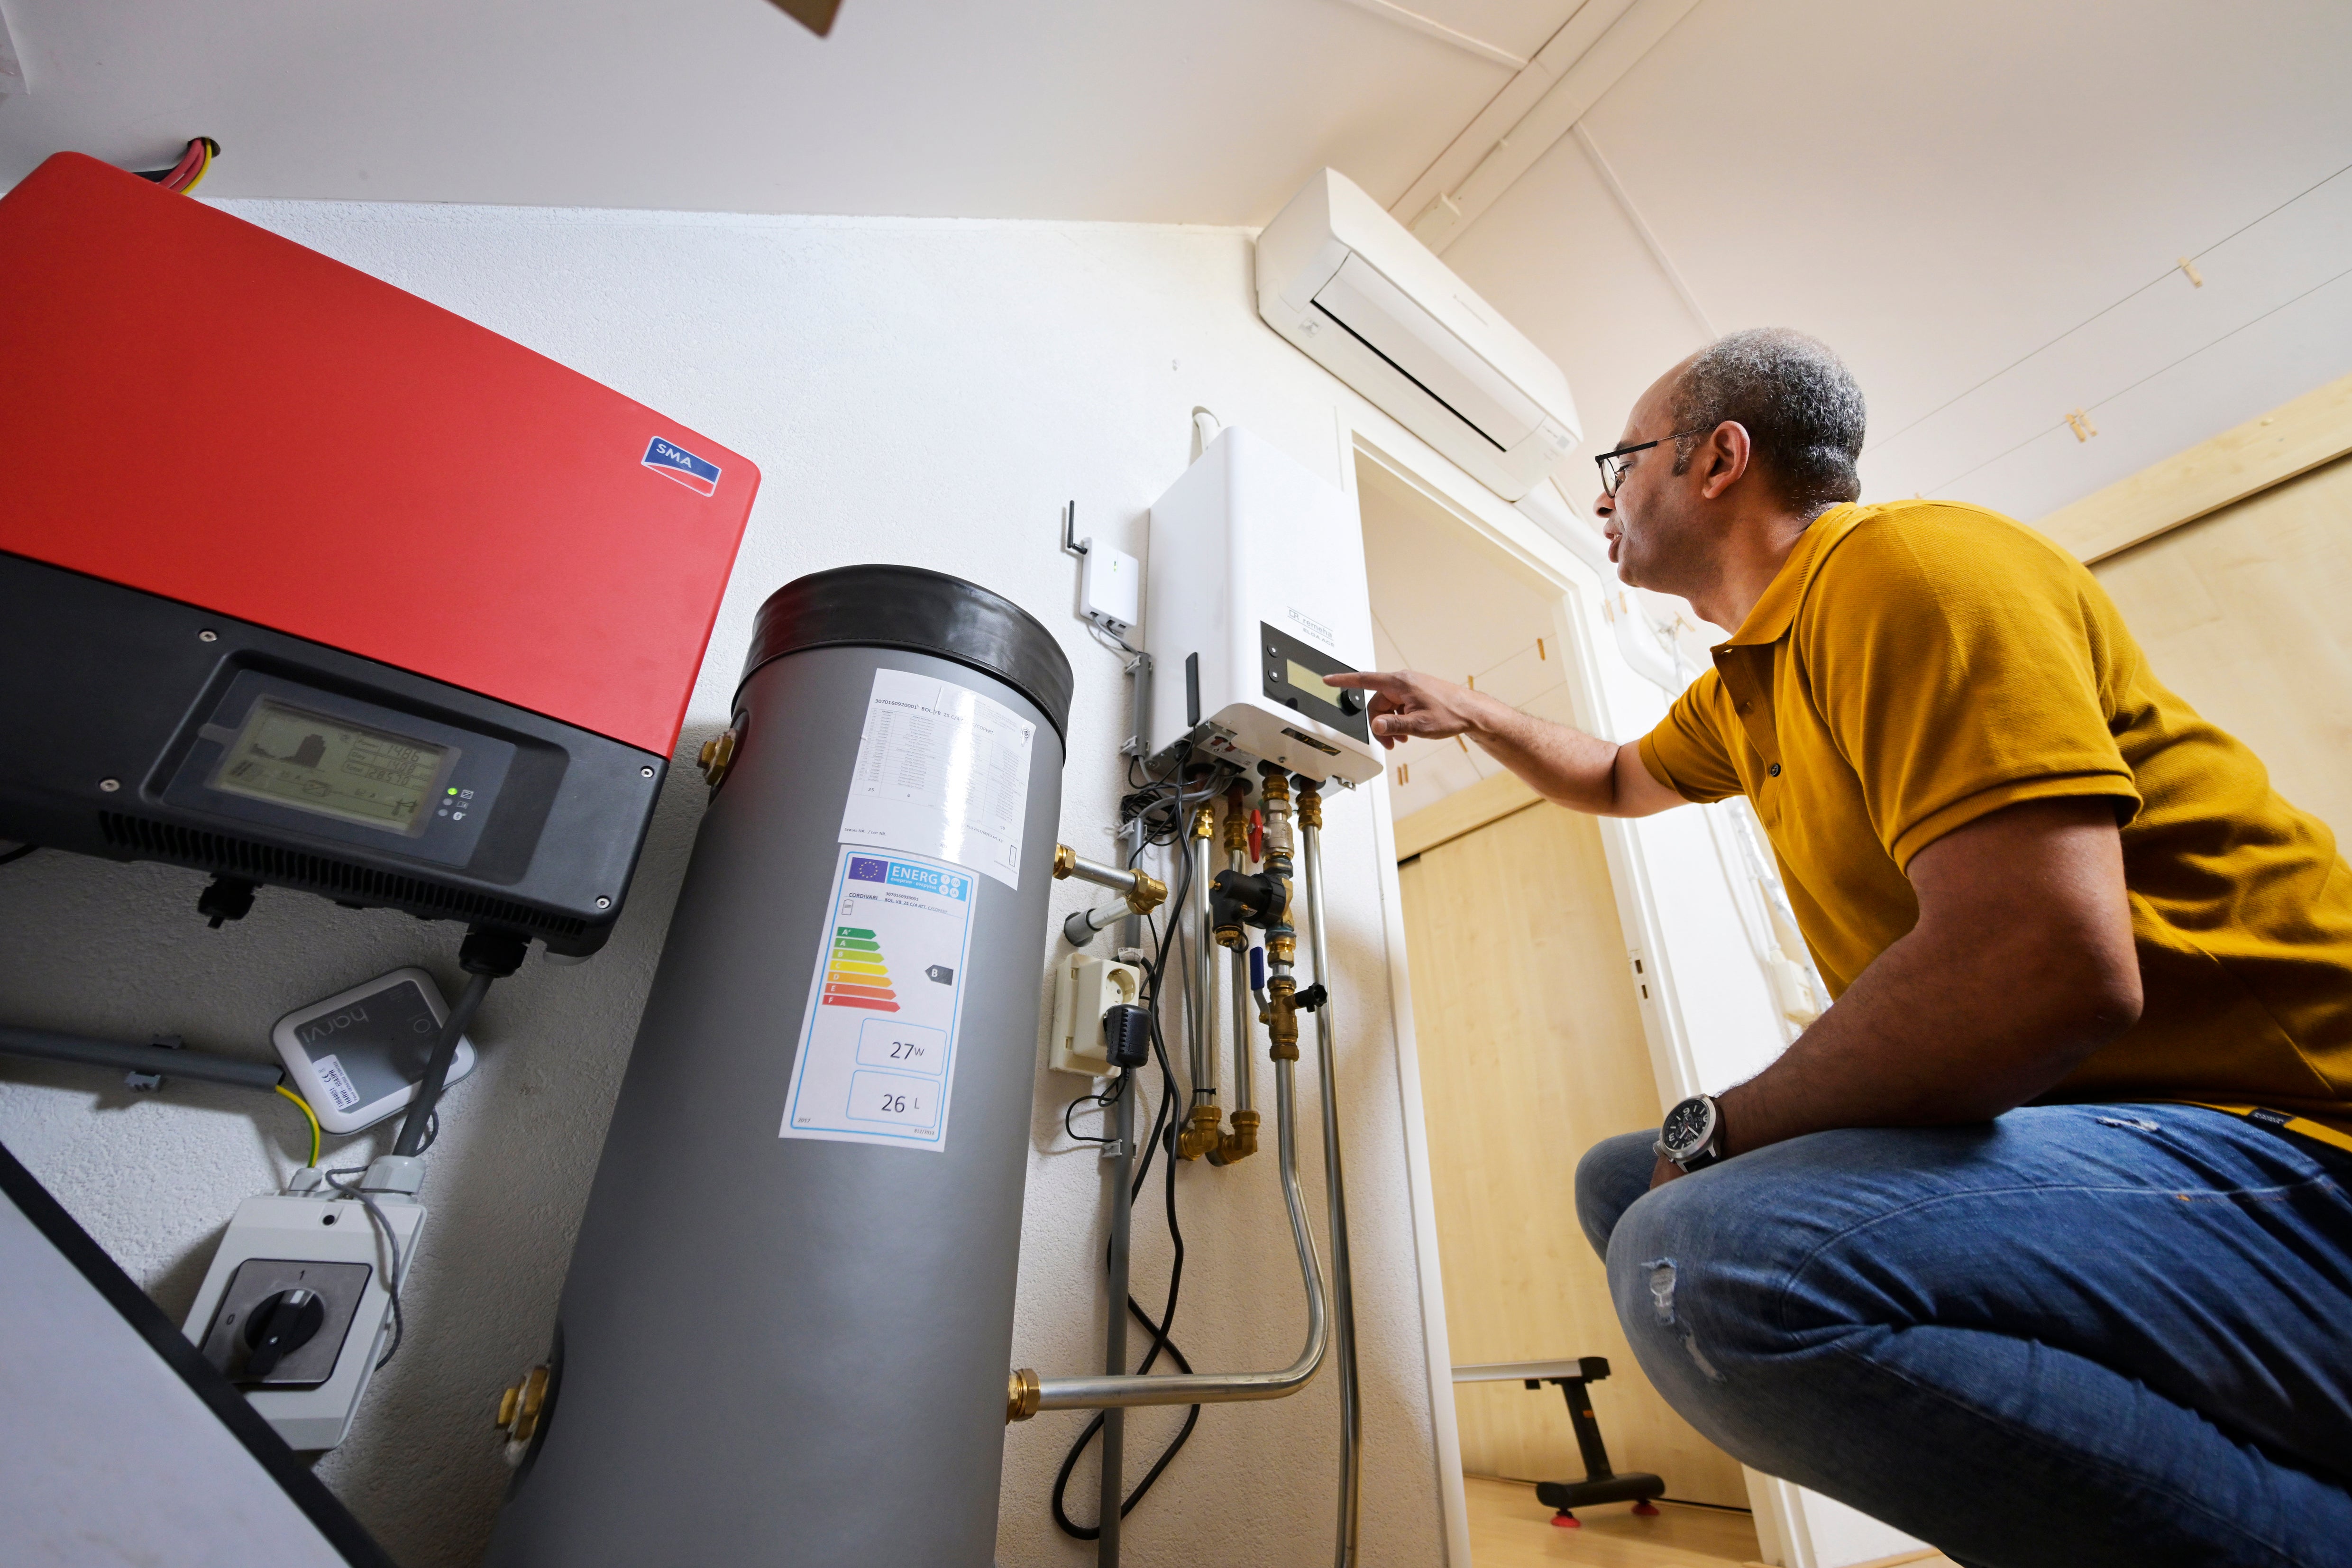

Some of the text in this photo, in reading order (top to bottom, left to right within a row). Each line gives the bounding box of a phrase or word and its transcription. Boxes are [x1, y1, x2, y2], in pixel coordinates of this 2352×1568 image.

[656, 444, 691, 468] SMA
[1303, 619, 1332, 638] remeha
[1303, 628, 1335, 648] ELGA ACE
[875, 699, 917, 709] 3070160920001
[351, 752, 366, 760] Day
[387, 745, 420, 762] 1486
[892, 866, 938, 885] ENERG
[886, 892, 918, 901] 3070160920001
[931, 969, 938, 977] B
[301, 1007, 369, 1044] harvi
[340, 1090, 352, 1104] HARVI
[881, 1094, 920, 1113] 26 L
[300, 1270, 305, 1281] 1
[226, 1314, 235, 1325] 0
